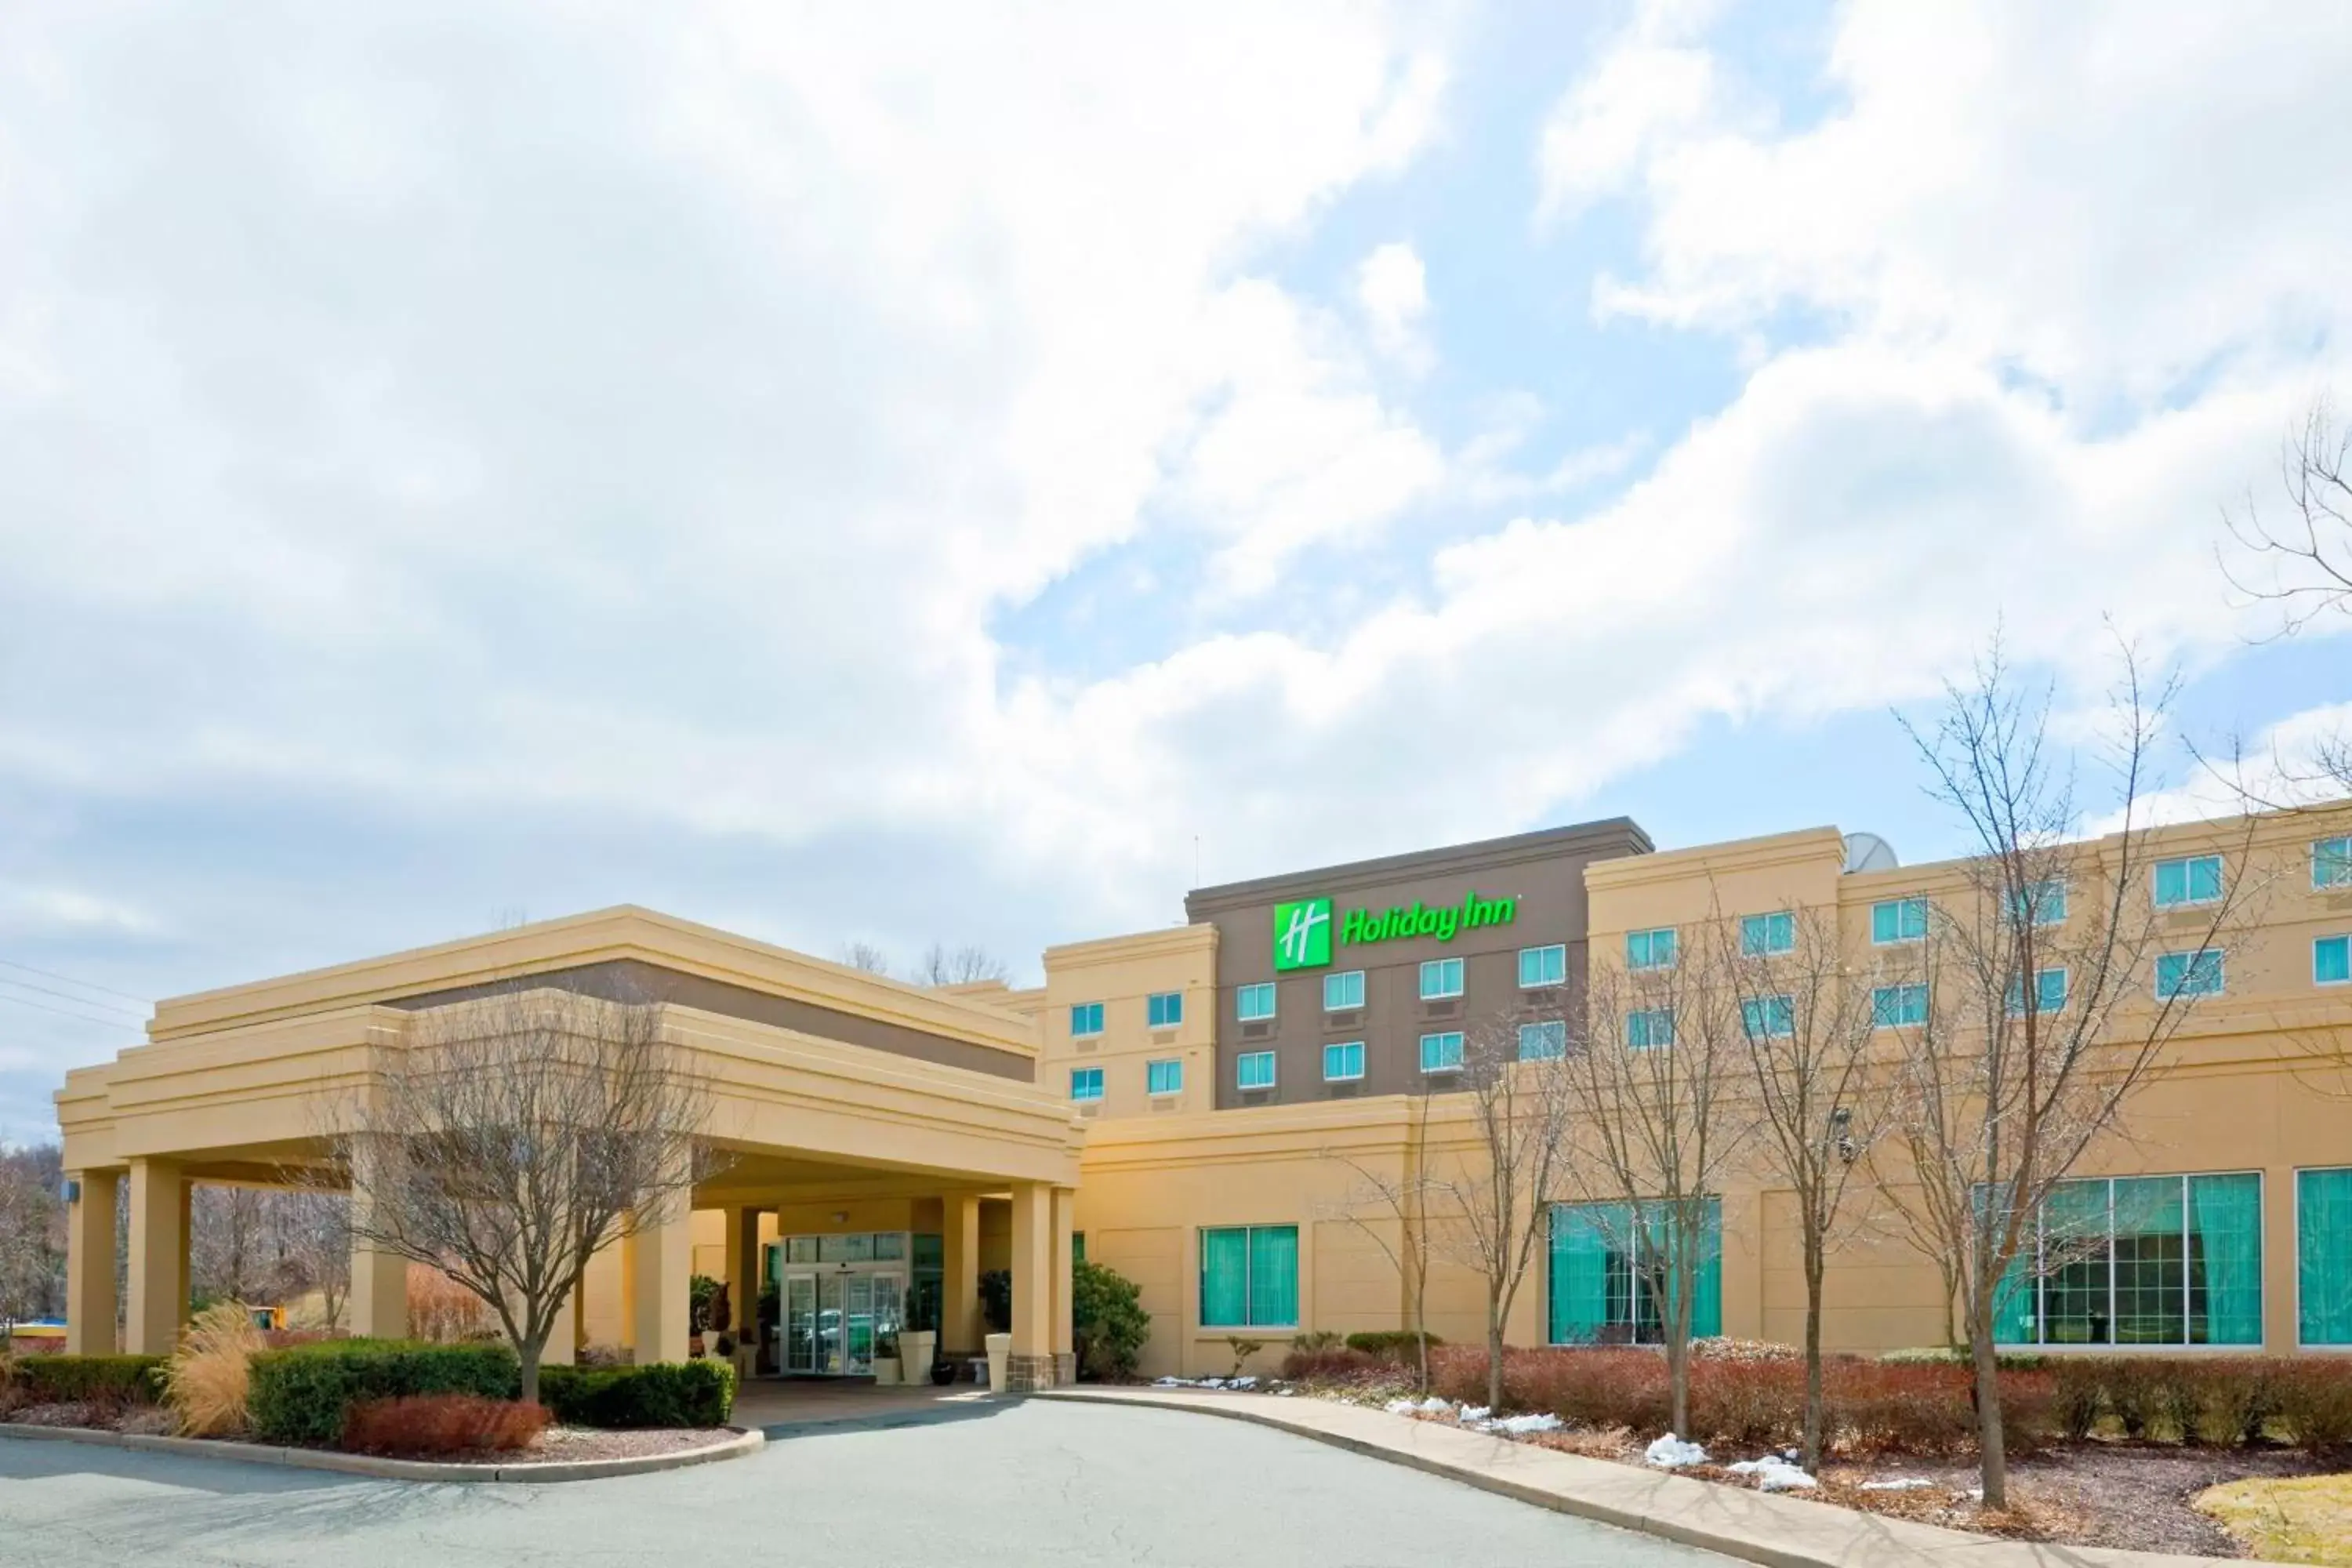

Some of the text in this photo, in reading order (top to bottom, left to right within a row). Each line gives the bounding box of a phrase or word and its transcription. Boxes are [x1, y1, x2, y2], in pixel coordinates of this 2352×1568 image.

[1279, 902, 1330, 963] H
[1340, 891, 1516, 946] Holiday Inn
